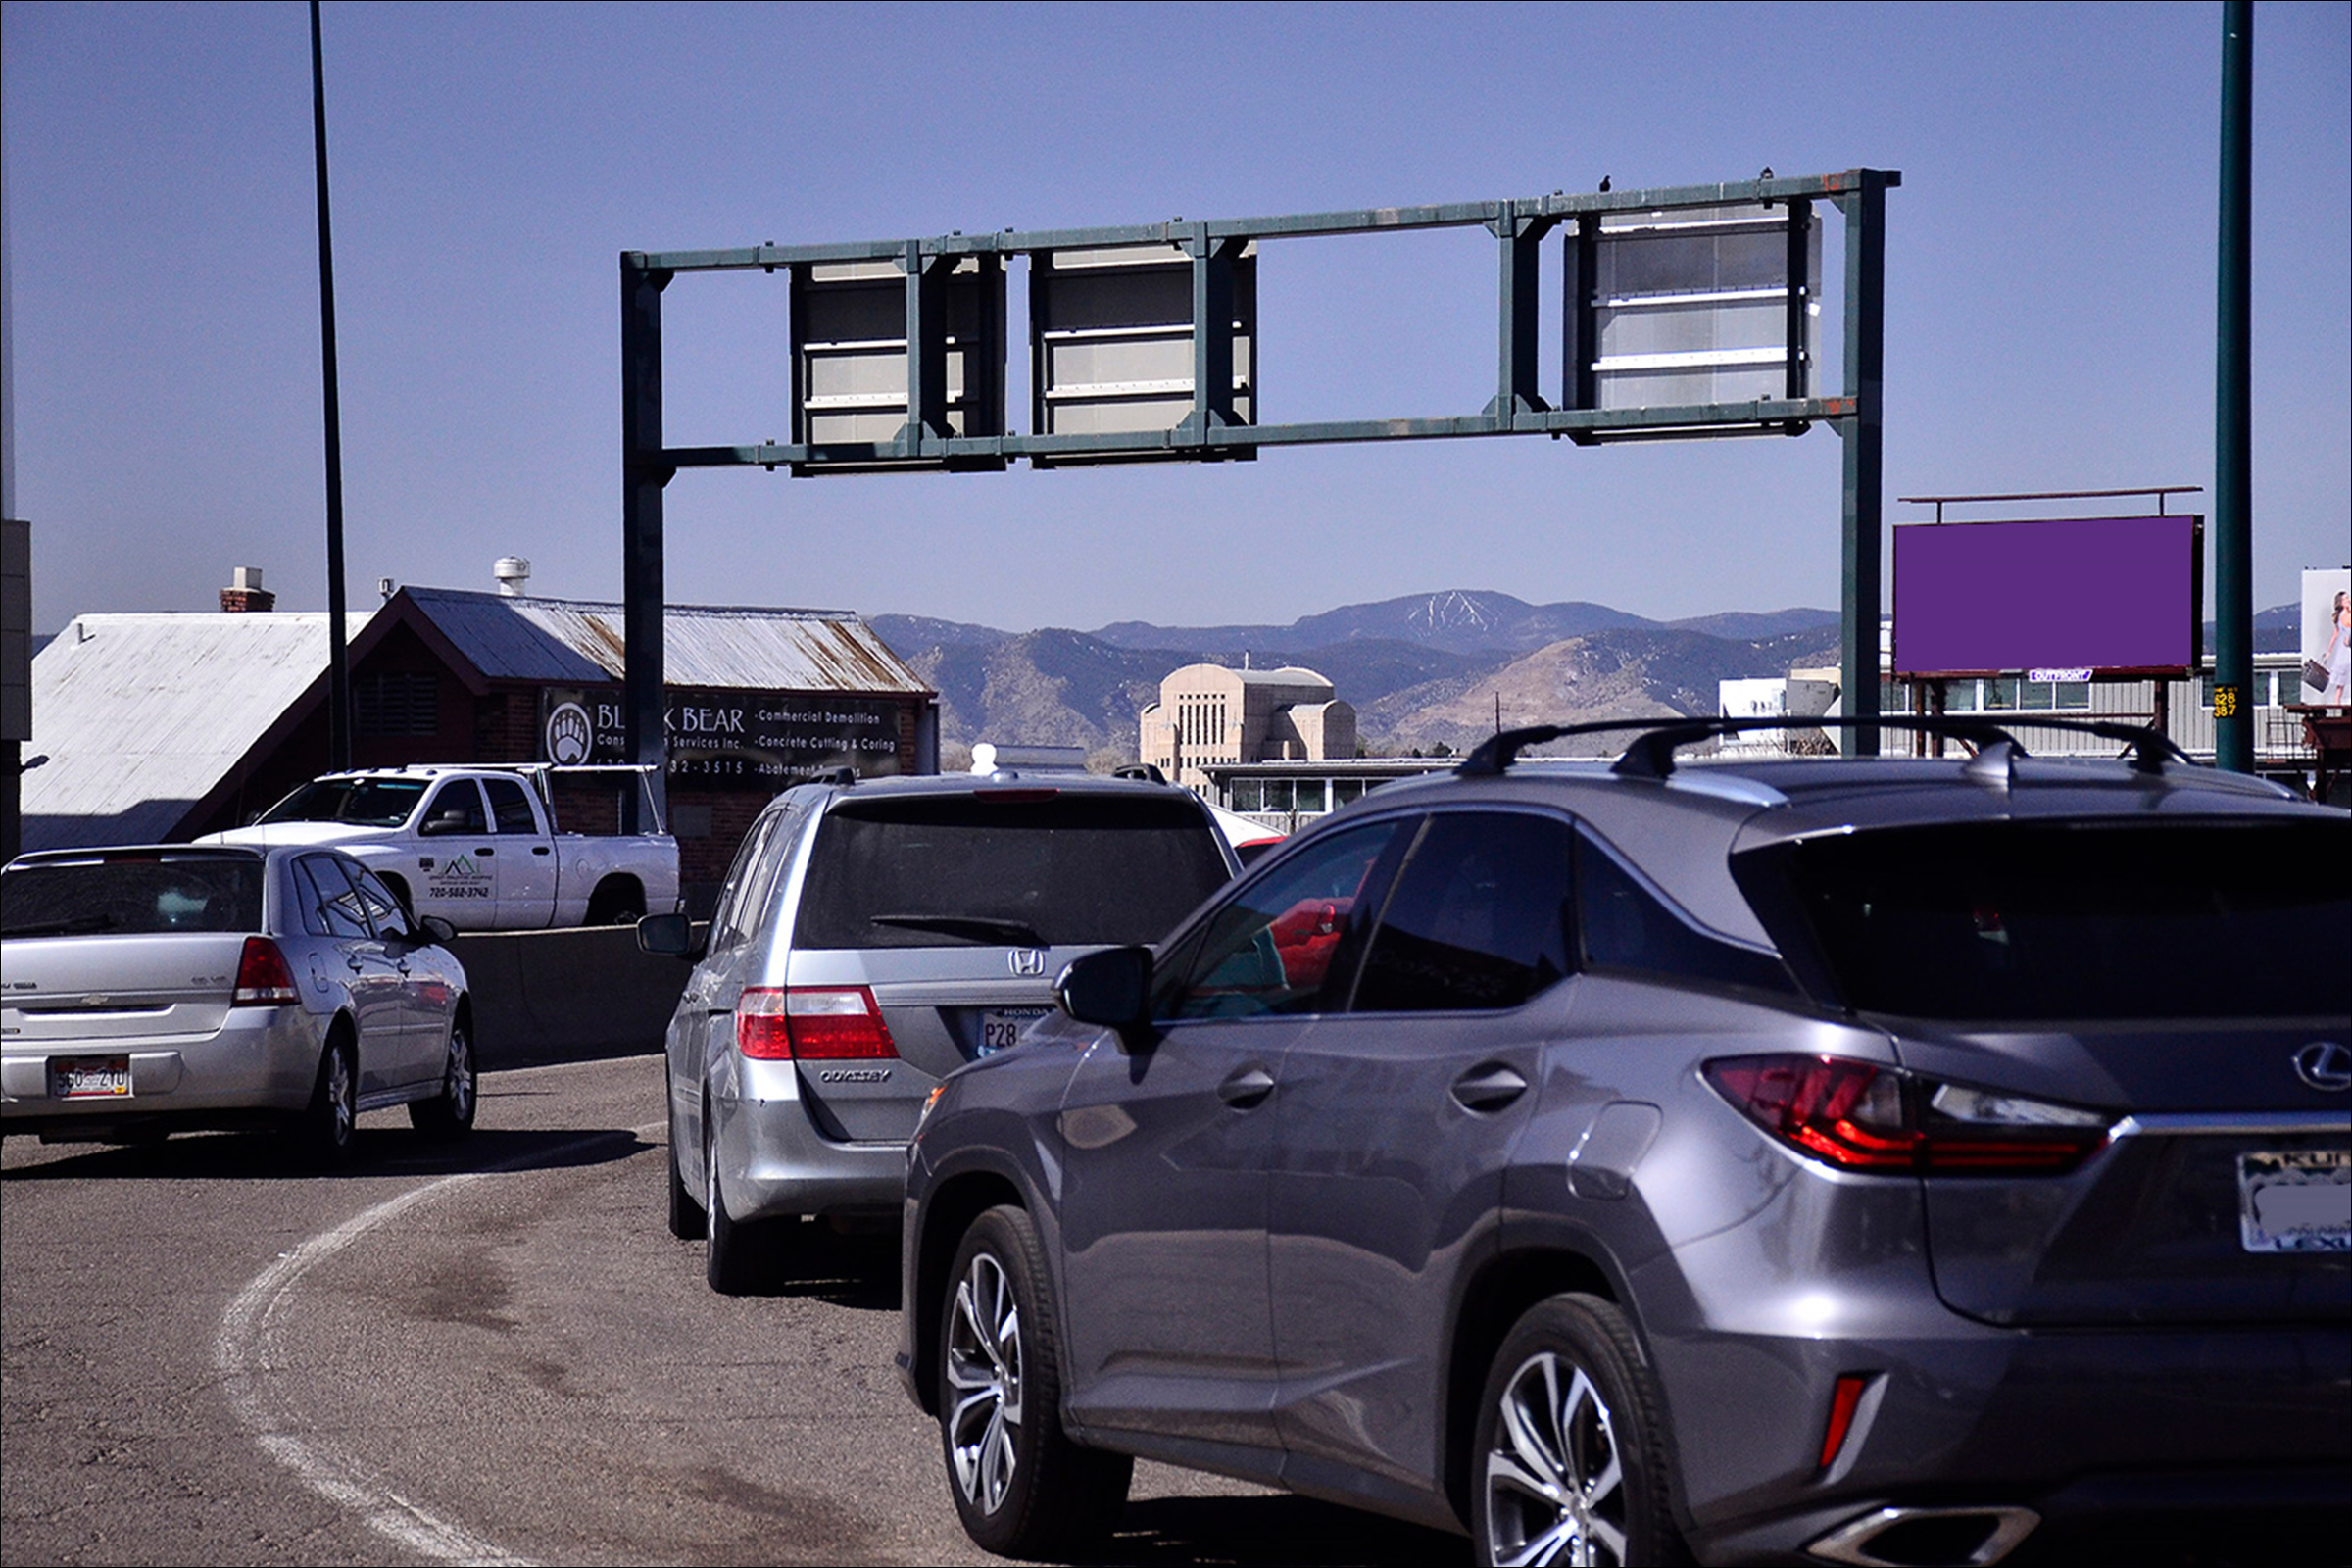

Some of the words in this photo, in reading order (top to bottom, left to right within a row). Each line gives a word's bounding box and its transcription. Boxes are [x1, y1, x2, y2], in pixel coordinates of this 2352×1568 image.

[597, 704, 676, 731] BLK
[683, 707, 745, 733] BEAR
[758, 709, 822, 722] Commercial
[824, 710, 880, 724] Demolition
[673, 737, 719, 749] Services
[722, 737, 744, 749] Inc.
[758, 735, 807, 748] Concrete
[809, 737, 848, 752] Cutting
[851, 738, 858, 749] &
[860, 738, 896, 753] Coring
[670, 760, 744, 774] 32-3515
[985, 1023, 1017, 1048] P28
[819, 1068, 892, 1083] ODYSSEY
